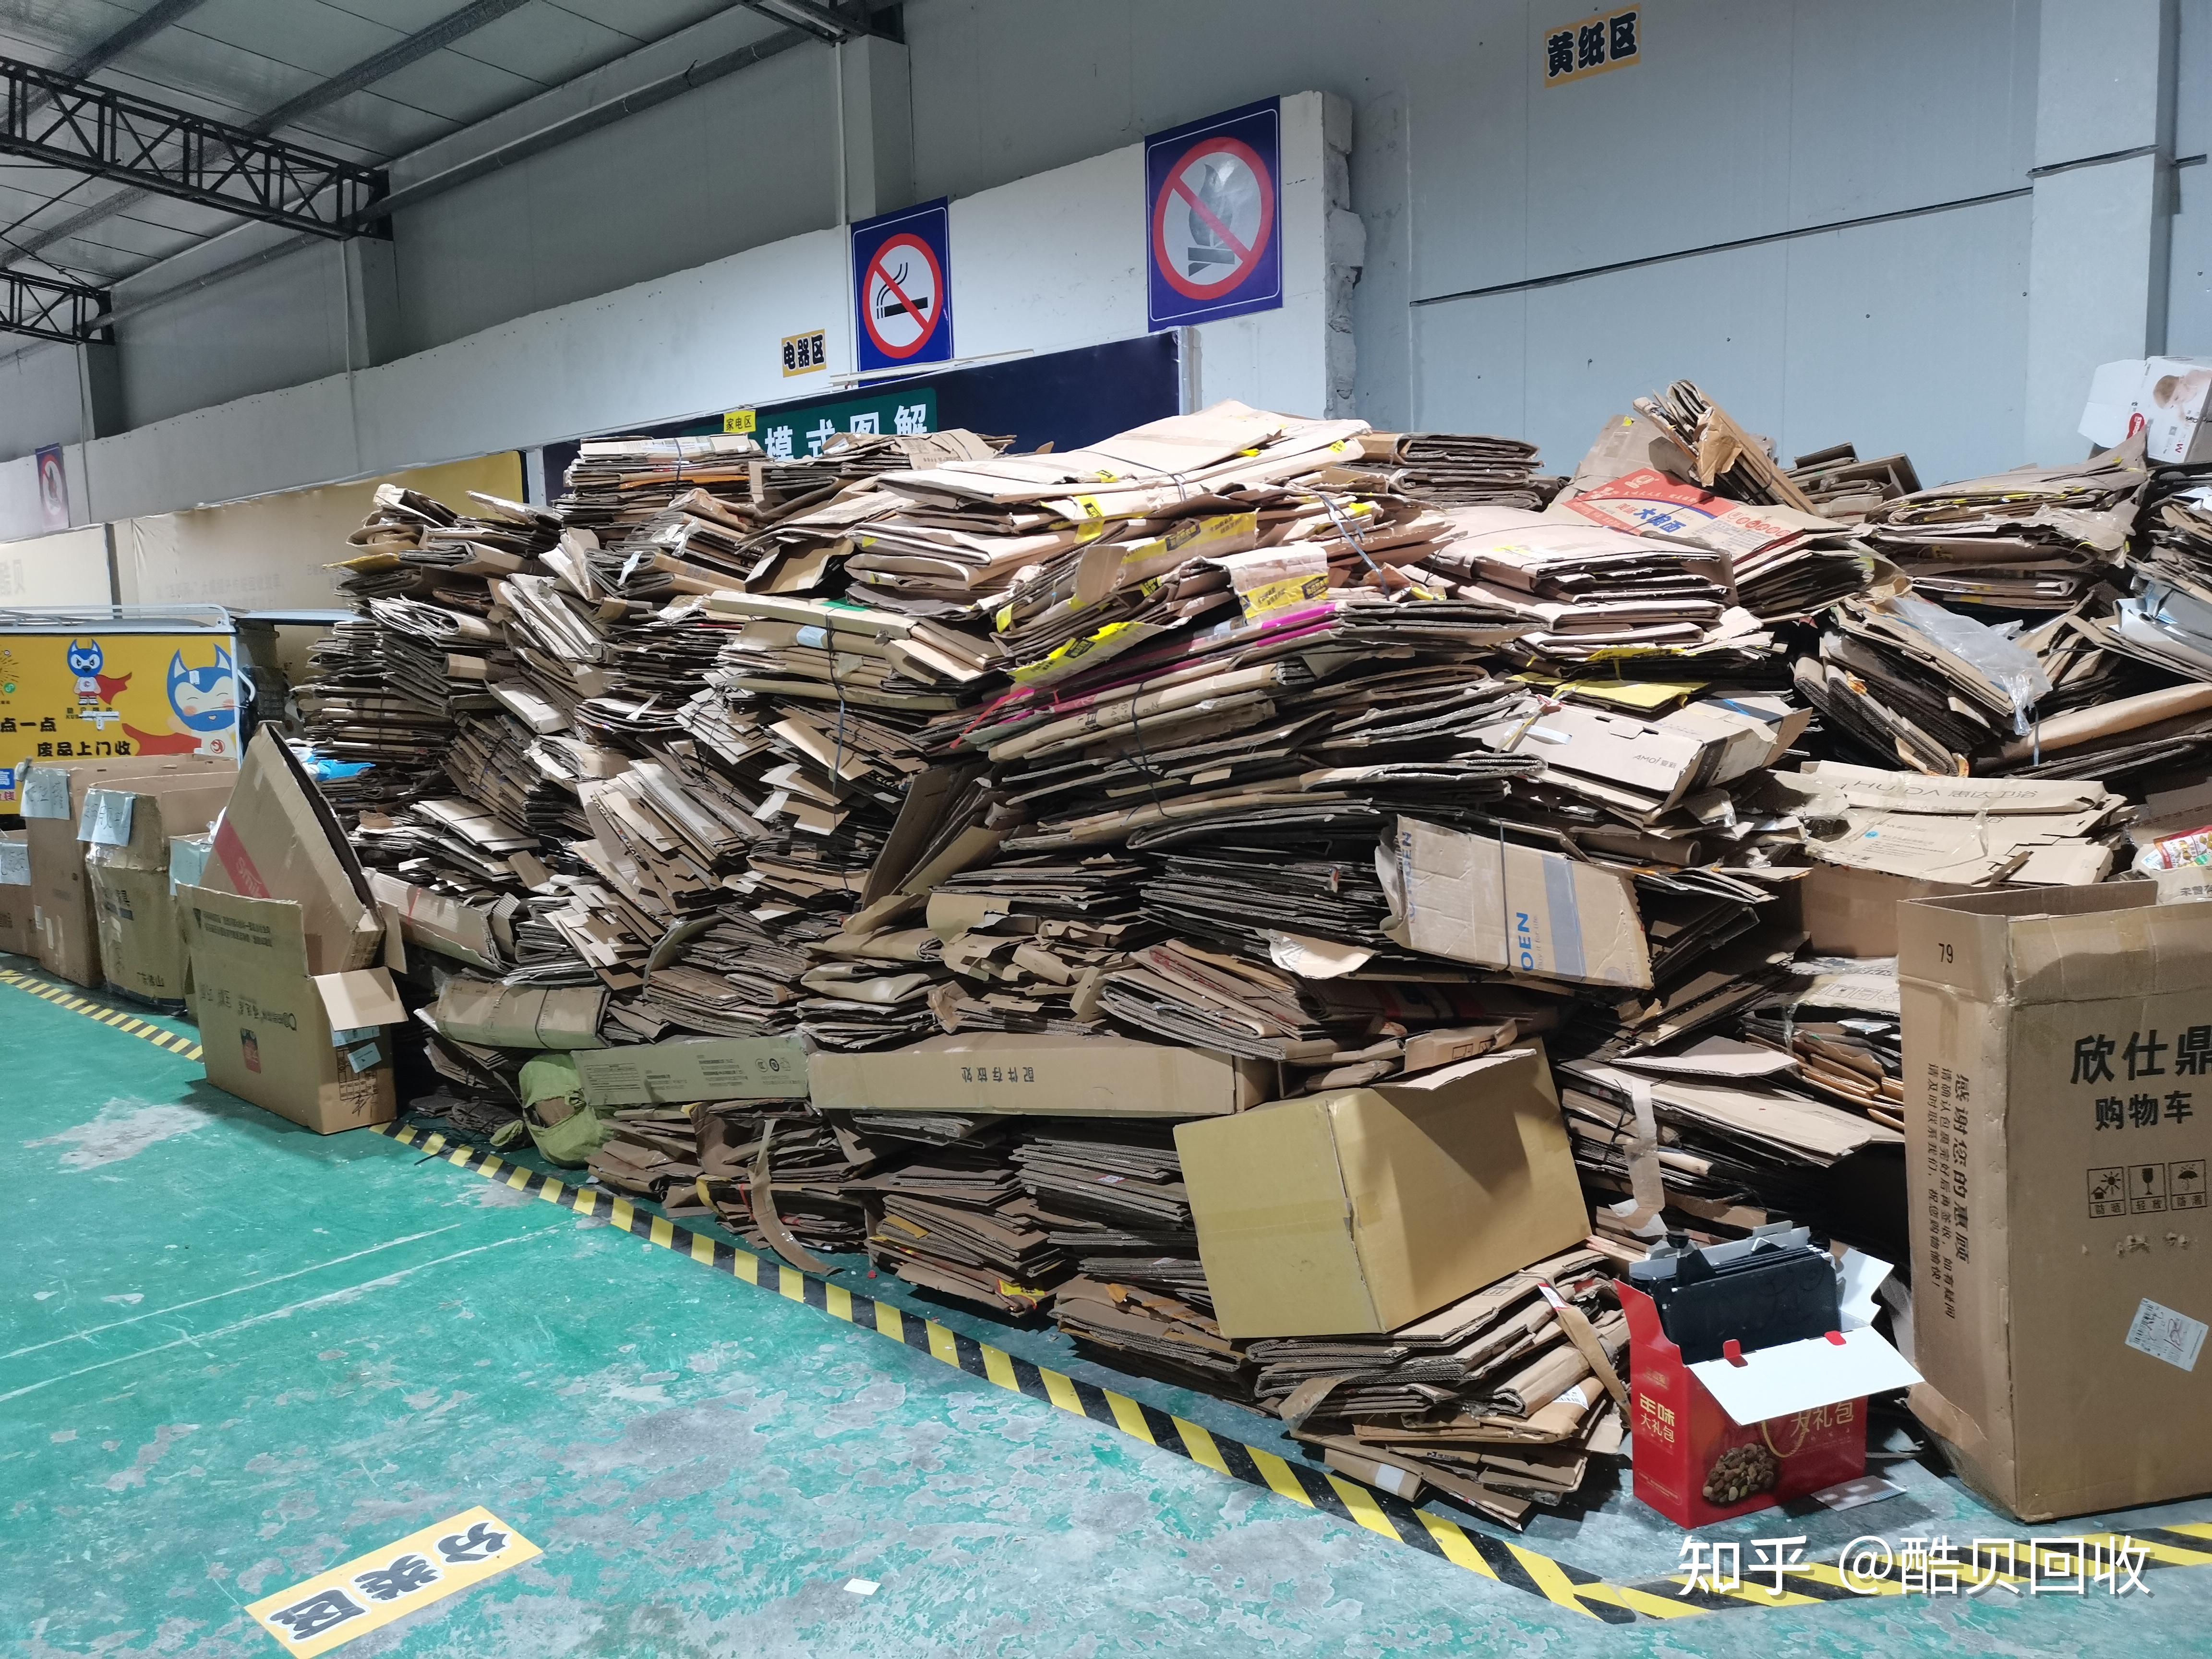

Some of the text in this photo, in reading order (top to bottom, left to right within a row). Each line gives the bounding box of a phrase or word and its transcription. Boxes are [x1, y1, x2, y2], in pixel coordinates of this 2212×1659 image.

[1548, 12, 1637, 77] 黄纸区
[783, 334, 825, 370] 电器区
[726, 415, 752, 431] 家电区
[765, 404, 927, 461] 模式图解
[37, 741, 132, 757] 废品上门收
[1853, 781, 1940, 797] HUDA
[1938, 943, 1953, 963] 79
[2070, 1025, 2212, 1084] 欣仕鼎
[961, 1067, 1035, 1082] 配件存放处
[2094, 1091, 2193, 1131] 购物车
[1639, 1393, 1675, 1427] 年味
[1640, 1413, 1675, 1443] 大礼包
[269, 1522, 508, 1641] 分类区
